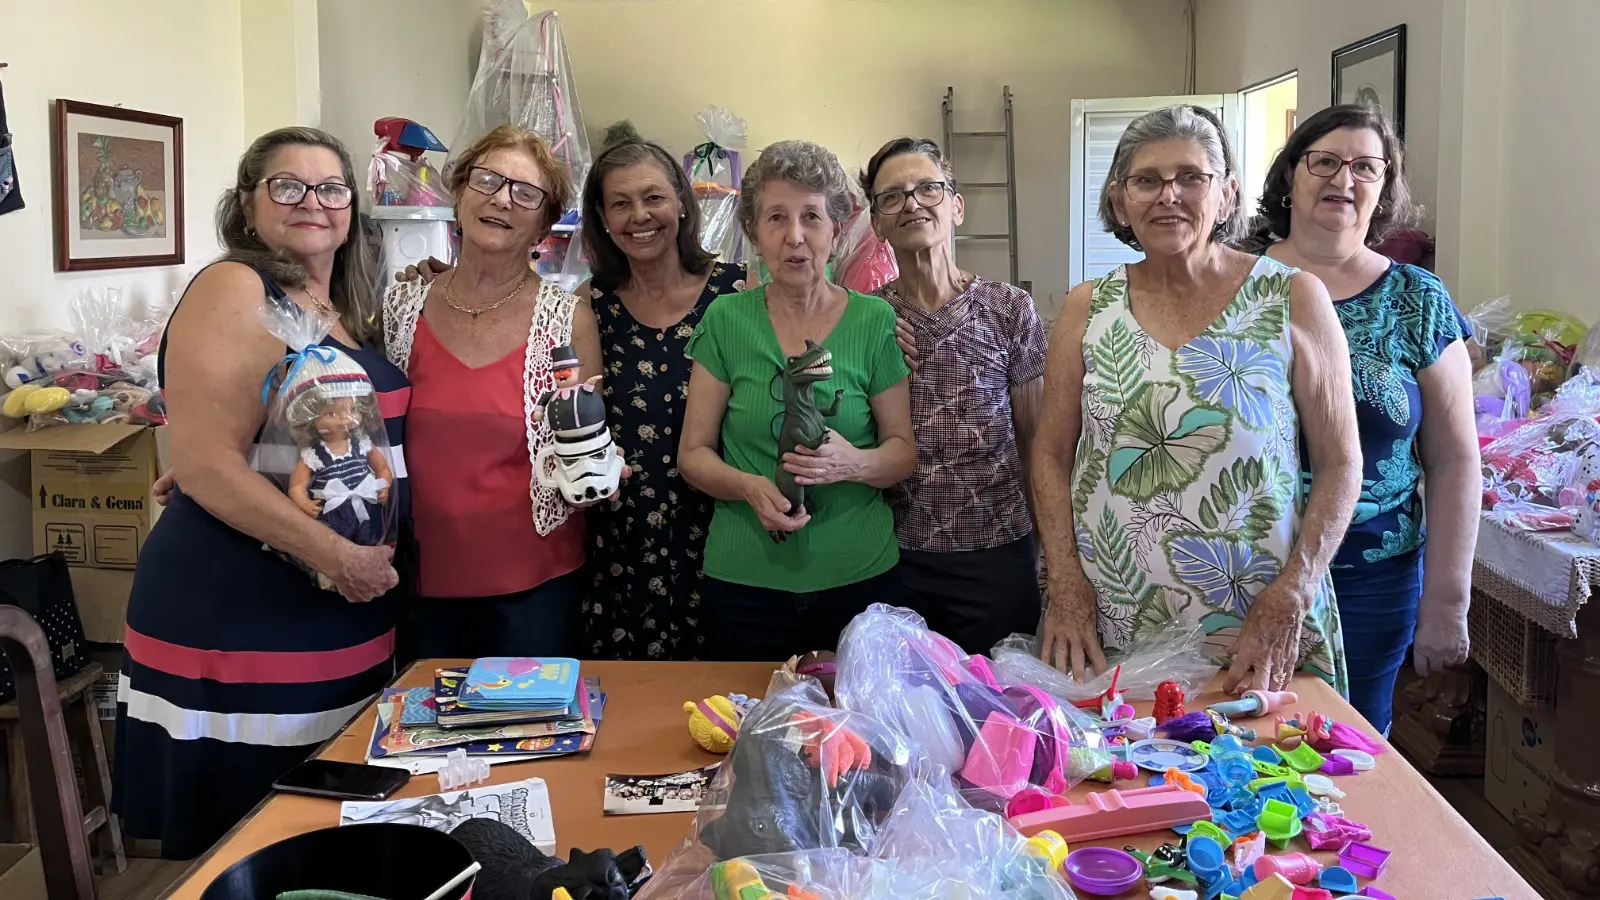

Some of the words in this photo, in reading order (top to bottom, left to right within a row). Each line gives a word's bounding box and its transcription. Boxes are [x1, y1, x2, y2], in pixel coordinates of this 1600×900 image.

[52, 493, 86, 508] Clara
[91, 496, 101, 509] &
[106, 496, 143, 510] Gema
